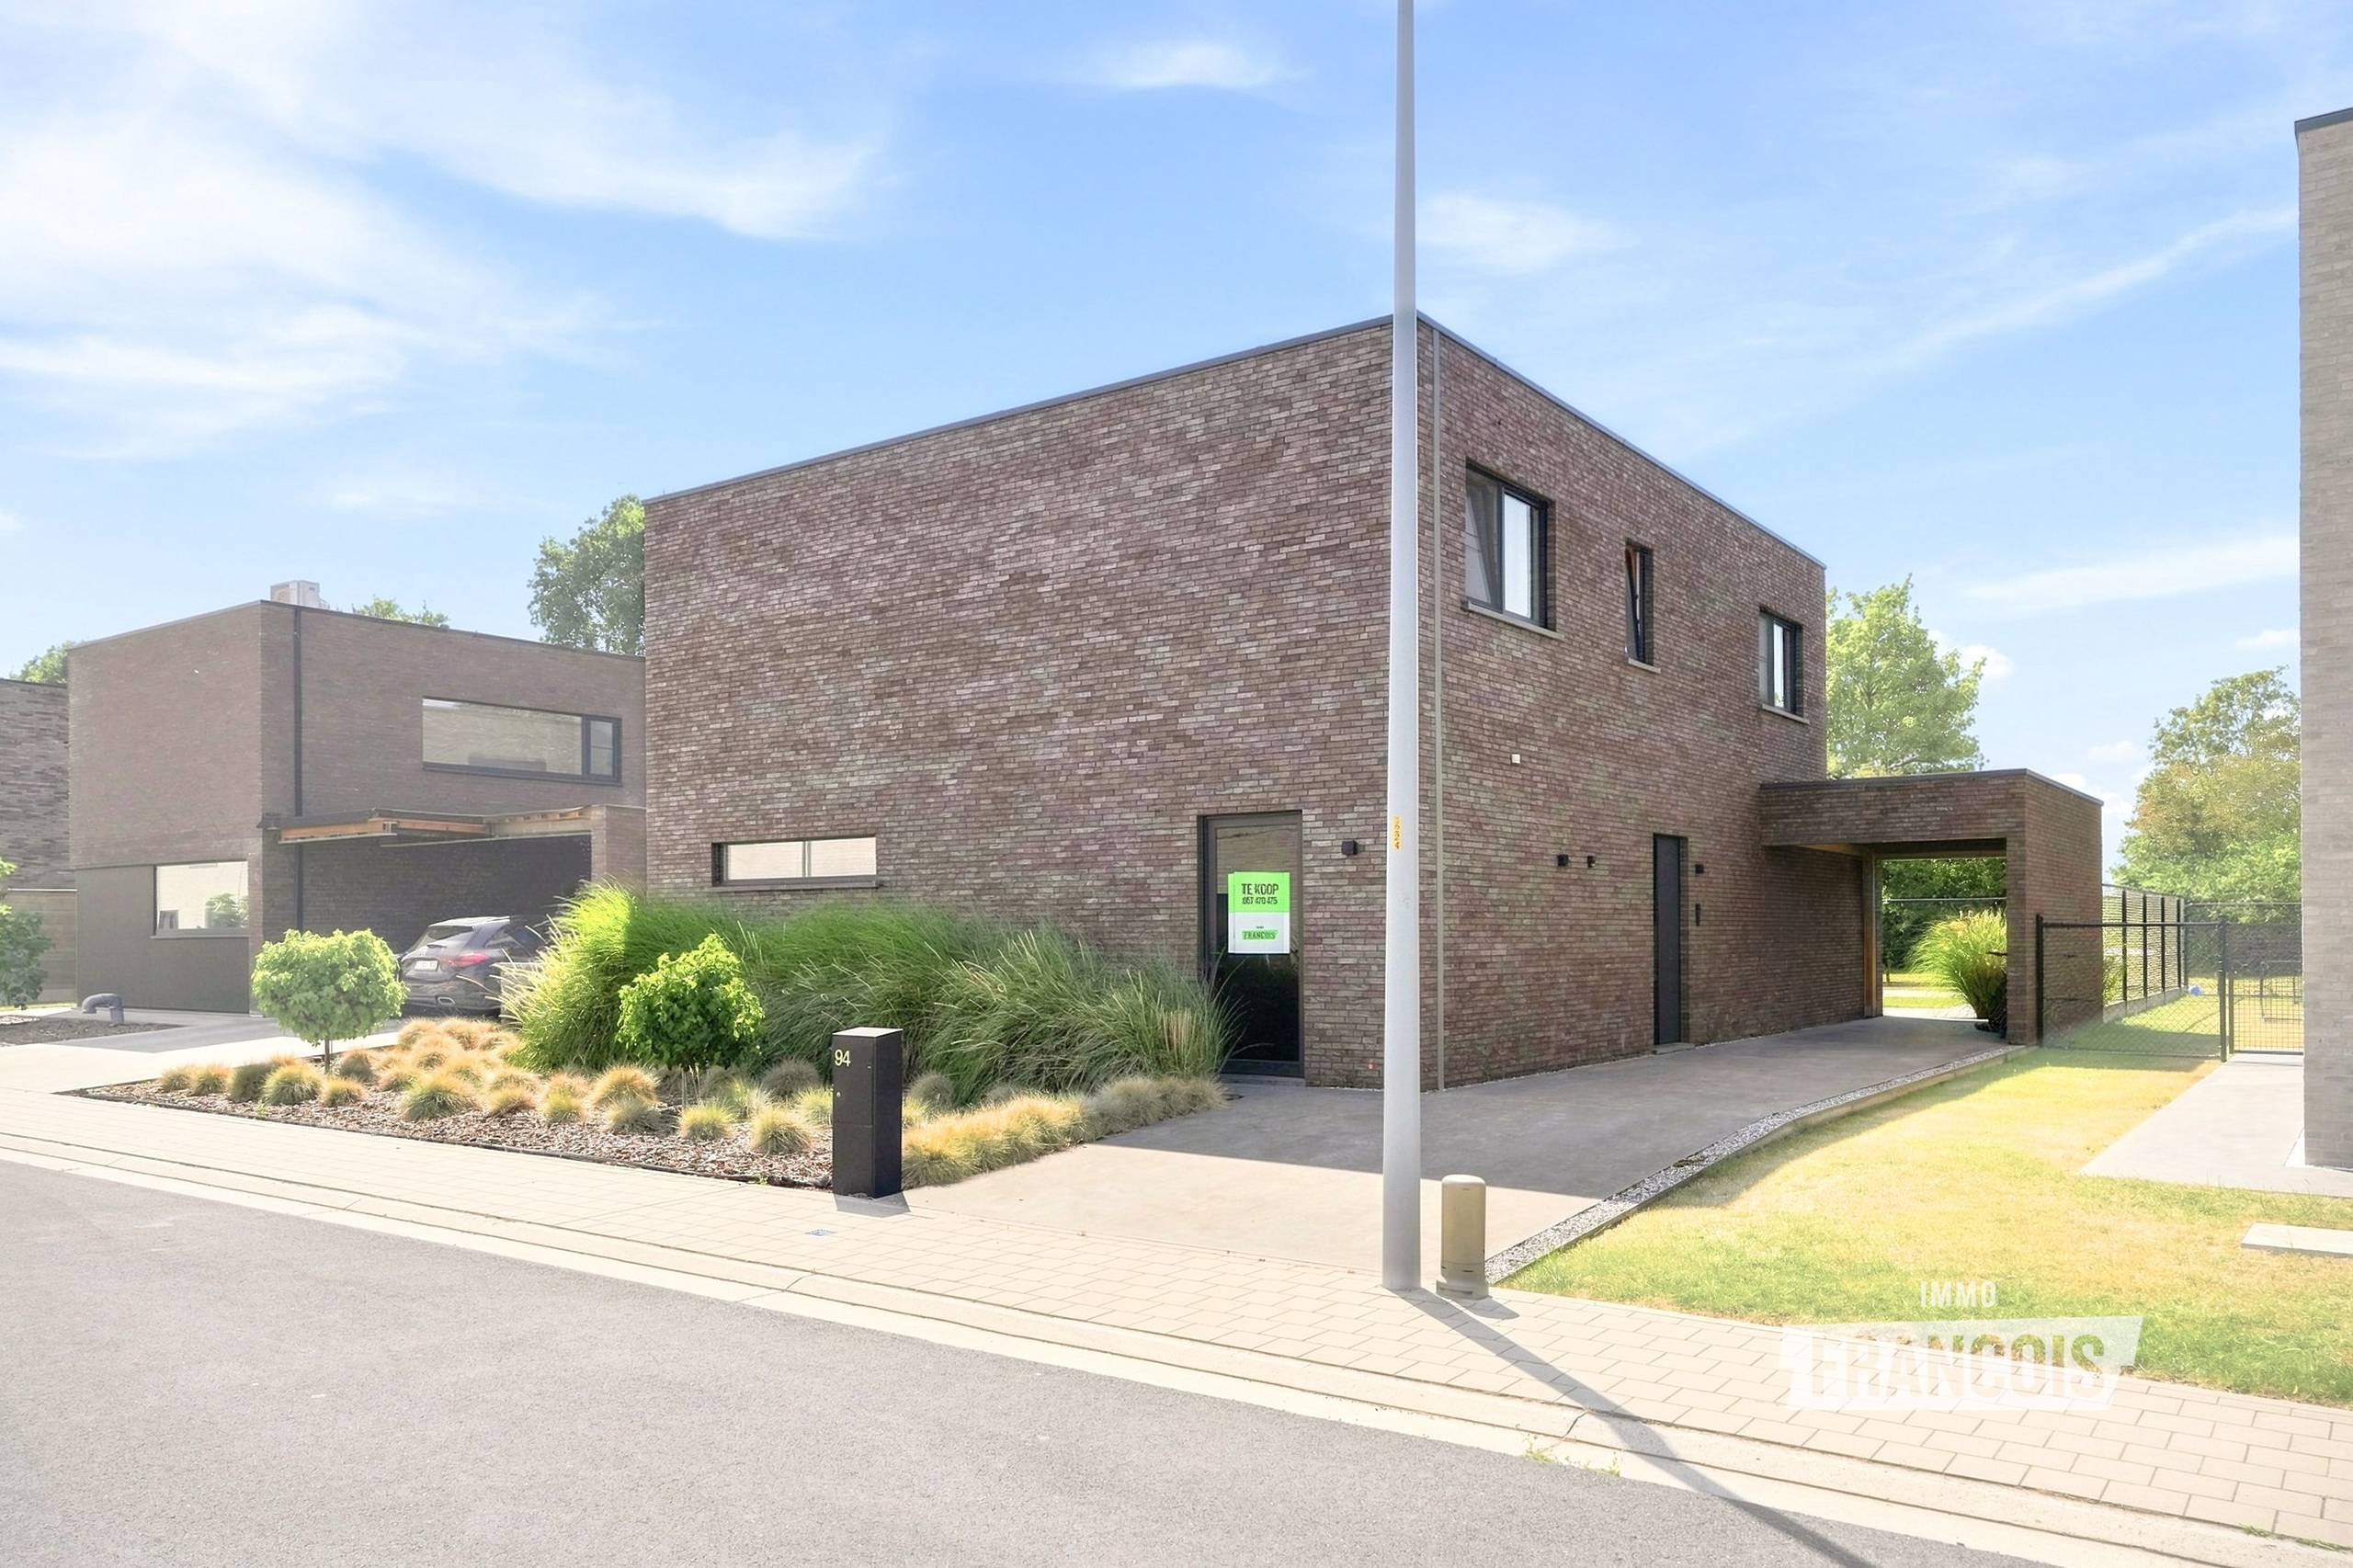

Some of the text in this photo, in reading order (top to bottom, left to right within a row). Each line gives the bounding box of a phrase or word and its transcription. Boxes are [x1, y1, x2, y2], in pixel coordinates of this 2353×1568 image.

[1241, 883, 1279, 895] TE KOOP
[834, 1049, 851, 1067] 94
